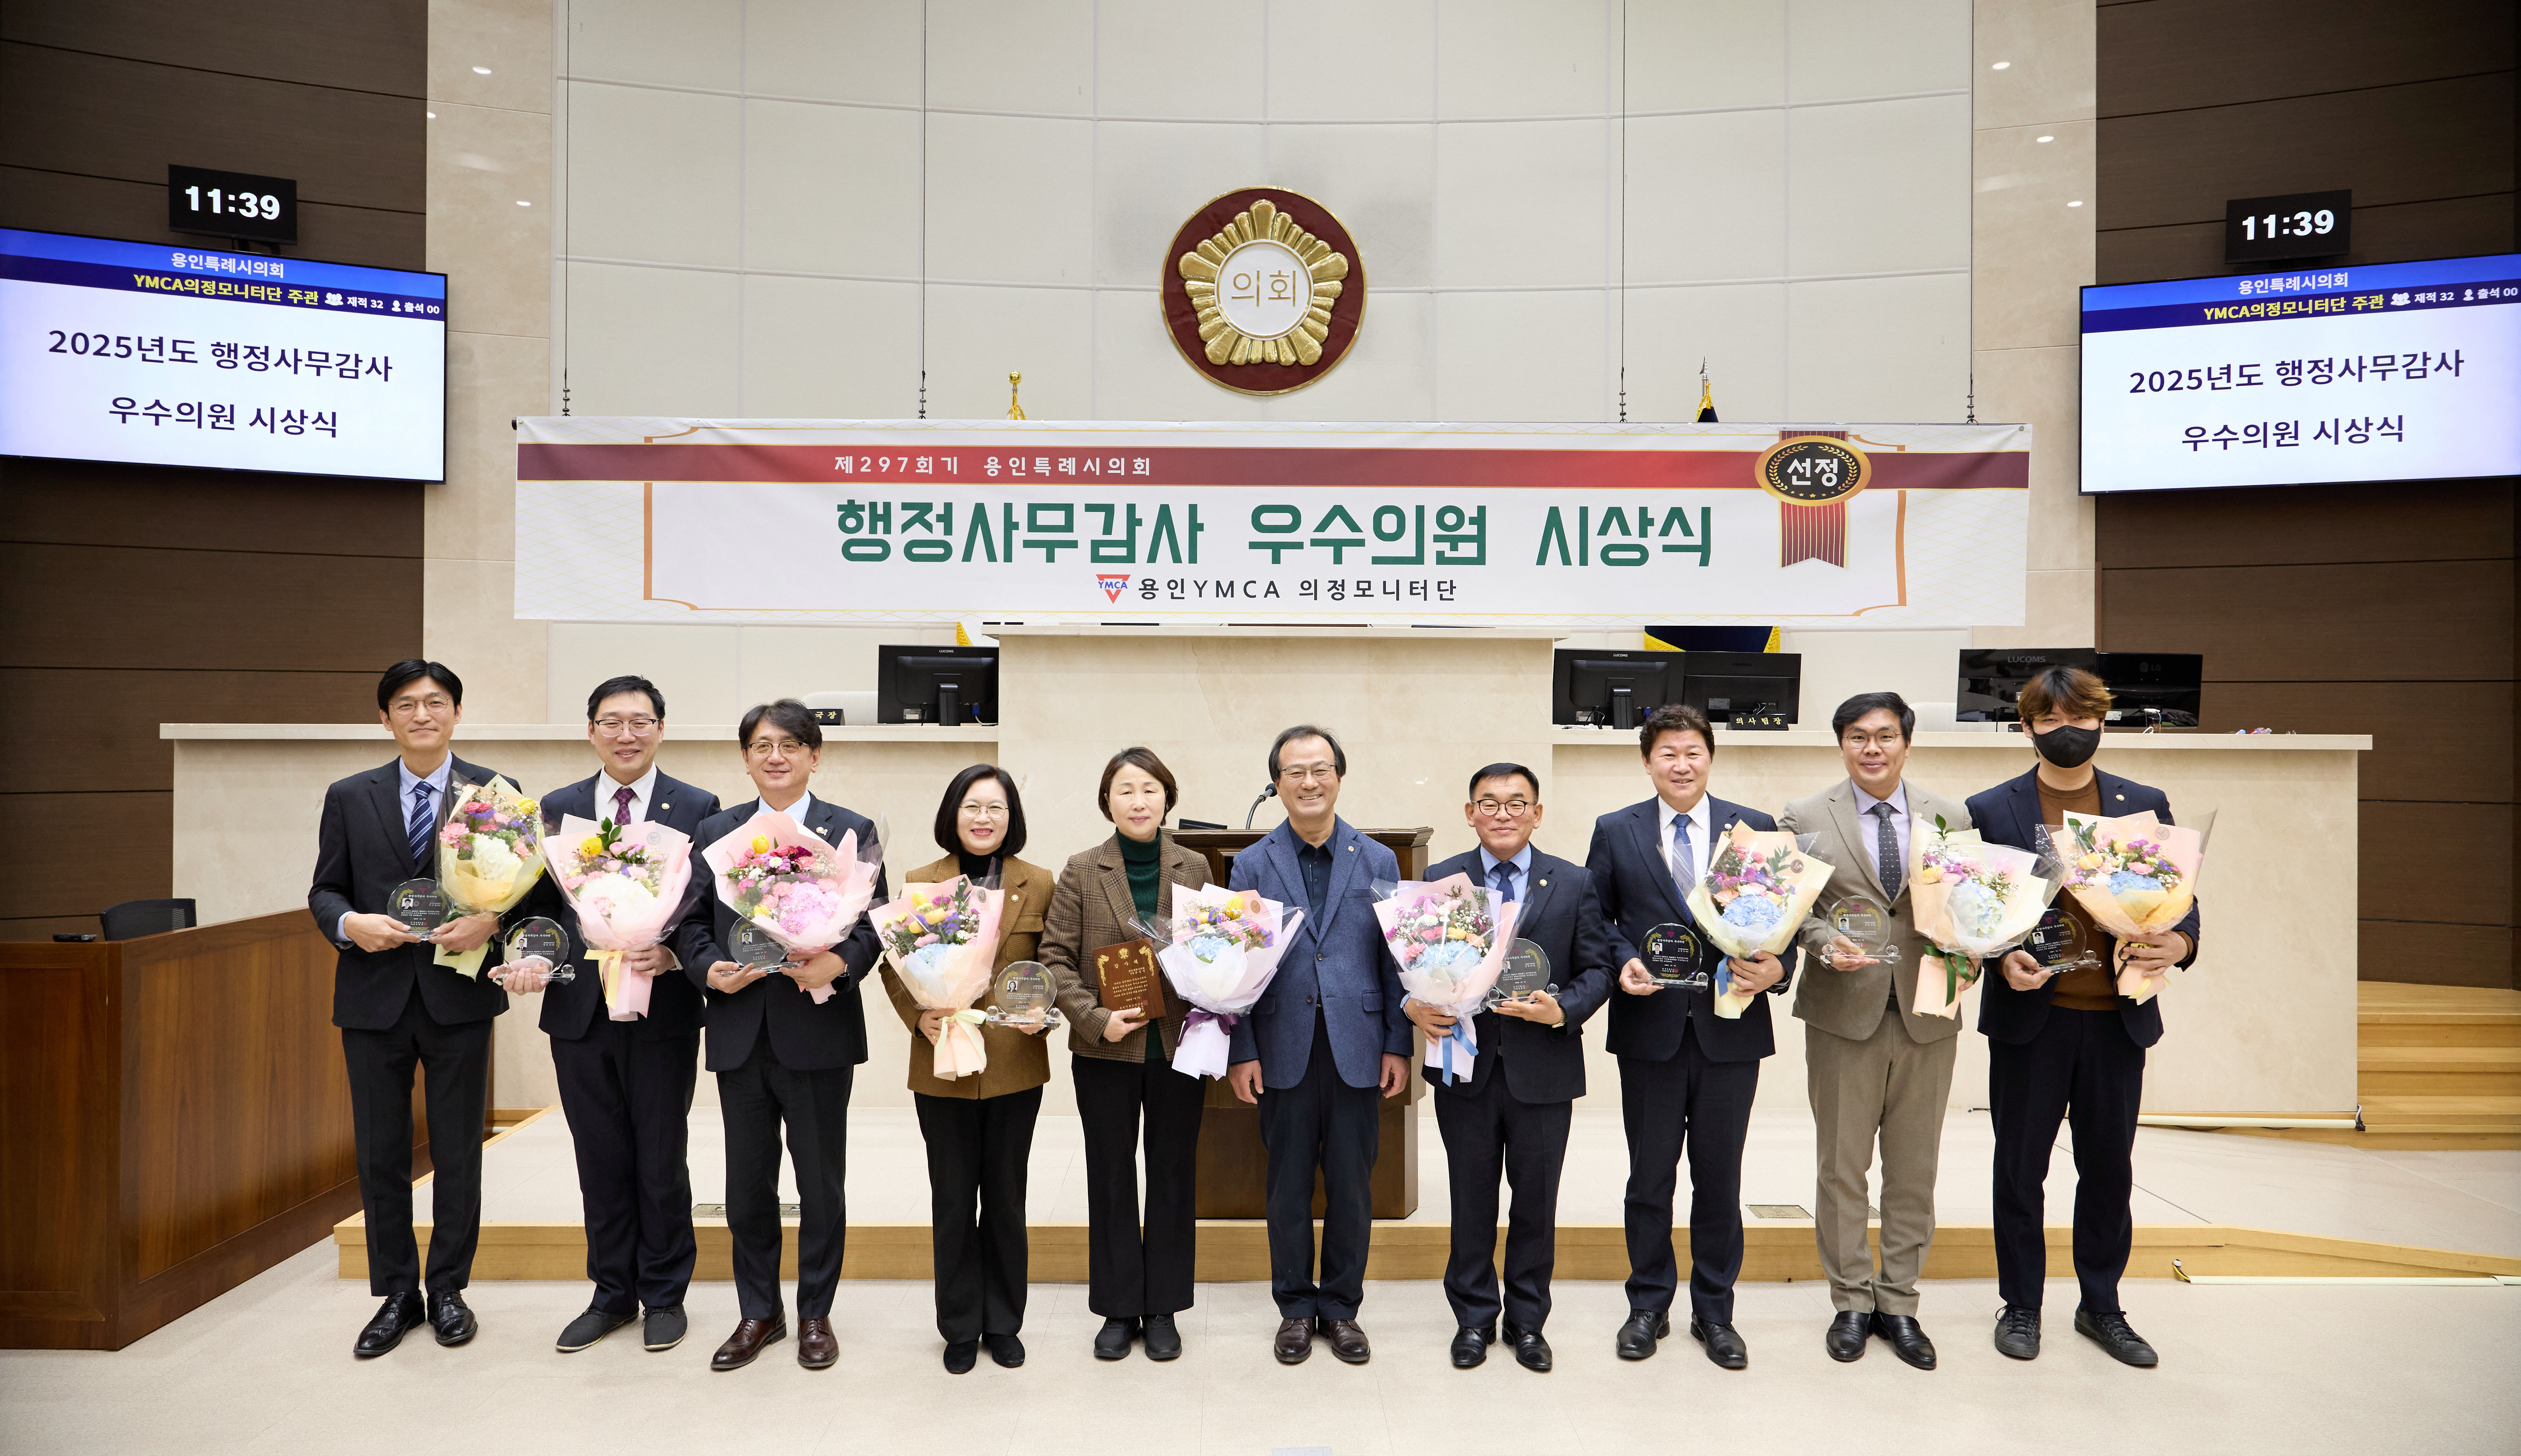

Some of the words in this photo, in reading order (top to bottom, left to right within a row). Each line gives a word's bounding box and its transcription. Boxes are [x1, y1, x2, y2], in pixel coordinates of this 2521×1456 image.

[186, 186, 280, 220] 11:39
[2242, 210, 2334, 240] 11:39
[171, 253, 283, 278] 용인특례시의회
[133, 274, 282, 302] YMCA의정모니터단
[288, 289, 318, 305] 주관
[1232, 270, 1295, 307] 의회
[2239, 272, 2348, 295] 용인특례시의회
[2414, 292, 2436, 303] 재적
[2440, 292, 2454, 301] 32
[2478, 288, 2499, 299] 출석
[2504, 288, 2518, 296] 00
[347, 297, 367, 308] 재적
[371, 300, 383, 308] 32
[404, 302, 423, 313] 출석
[427, 305, 440, 314] 00
[2204, 297, 2345, 320] YMCA의정모니터단
[2352, 294, 2384, 310] 주관
[49, 331, 198, 363] 2025년도
[211, 342, 392, 382] 행정사무감사
[2130, 364, 2263, 393] 2025년도
[2276, 350, 2464, 386] 행정사무감사
[110, 398, 234, 430] 우수의원
[249, 407, 336, 438] 시상식
[2182, 421, 2299, 451] 우수의원
[2313, 415, 2402, 445] 시상식
[835, 456, 957, 474] 제297회기
[984, 457, 1149, 476] 용인특례시의회
[1787, 458, 1837, 486] 선정
[837, 500, 1204, 564] 행정사무감사
[1249, 505, 1486, 565] 우수의원
[1536, 506, 1711, 566] 시상식
[1138, 579, 1280, 600] 용인YMCA
[1299, 579, 1456, 601] 의정모니터단
